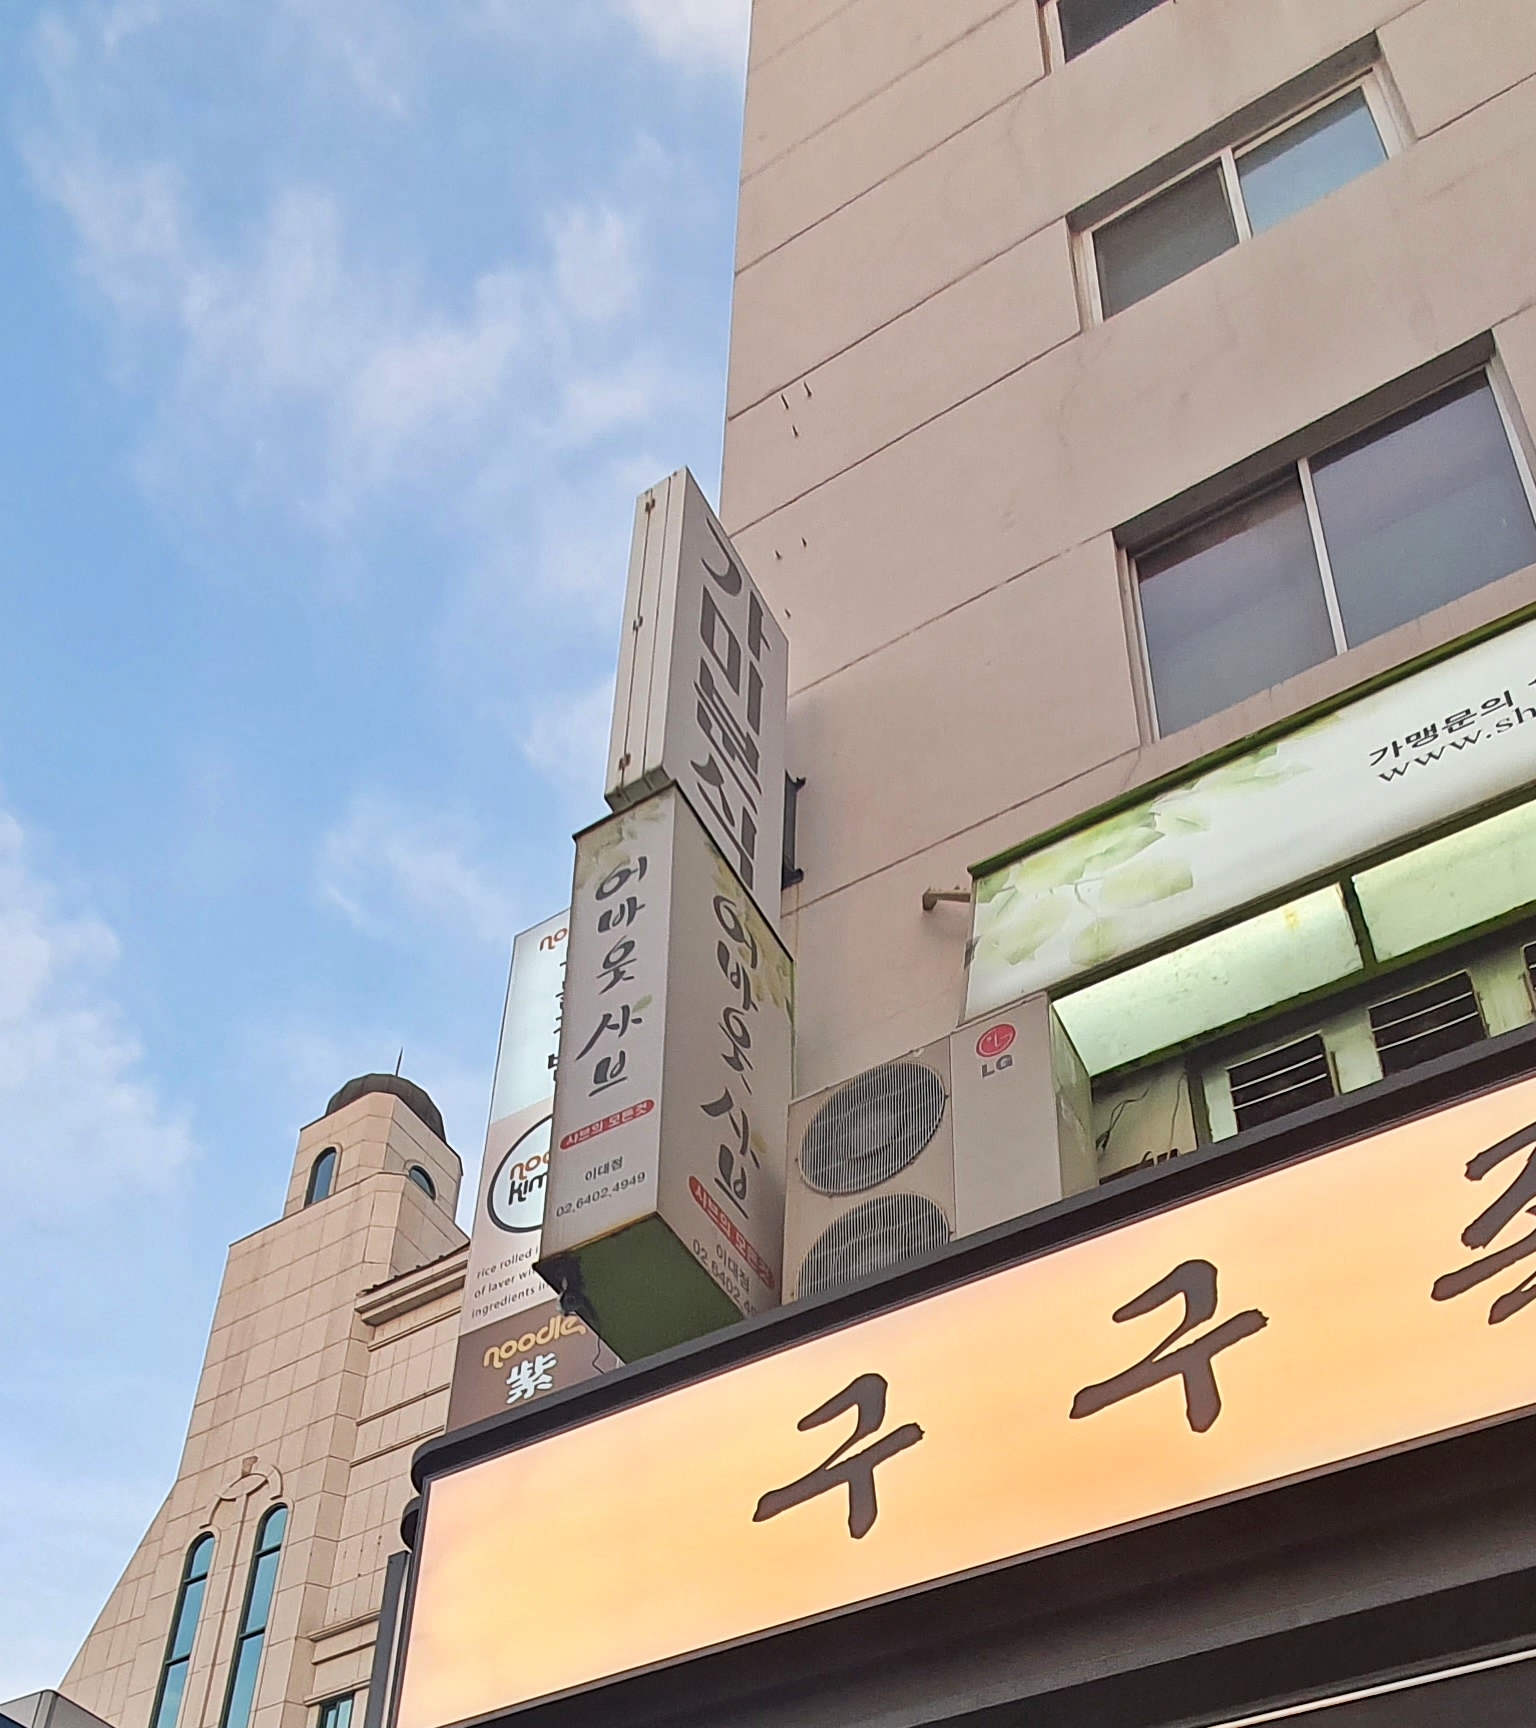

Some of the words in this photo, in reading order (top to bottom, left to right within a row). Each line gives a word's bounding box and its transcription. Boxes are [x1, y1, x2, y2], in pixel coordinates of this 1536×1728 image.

[1369, 690, 1514, 767] 가맹문의
[981, 1053, 1014, 1080] LG
[585, 1156, 624, 1182] 이대점
[476, 1264, 497, 1280] rice
[499, 1249, 532, 1270] rolled
[474, 1283, 487, 1298] of
[488, 1273, 516, 1295] laver
[471, 1287, 536, 1318] ingredients
[483, 1314, 587, 1368] noodle
